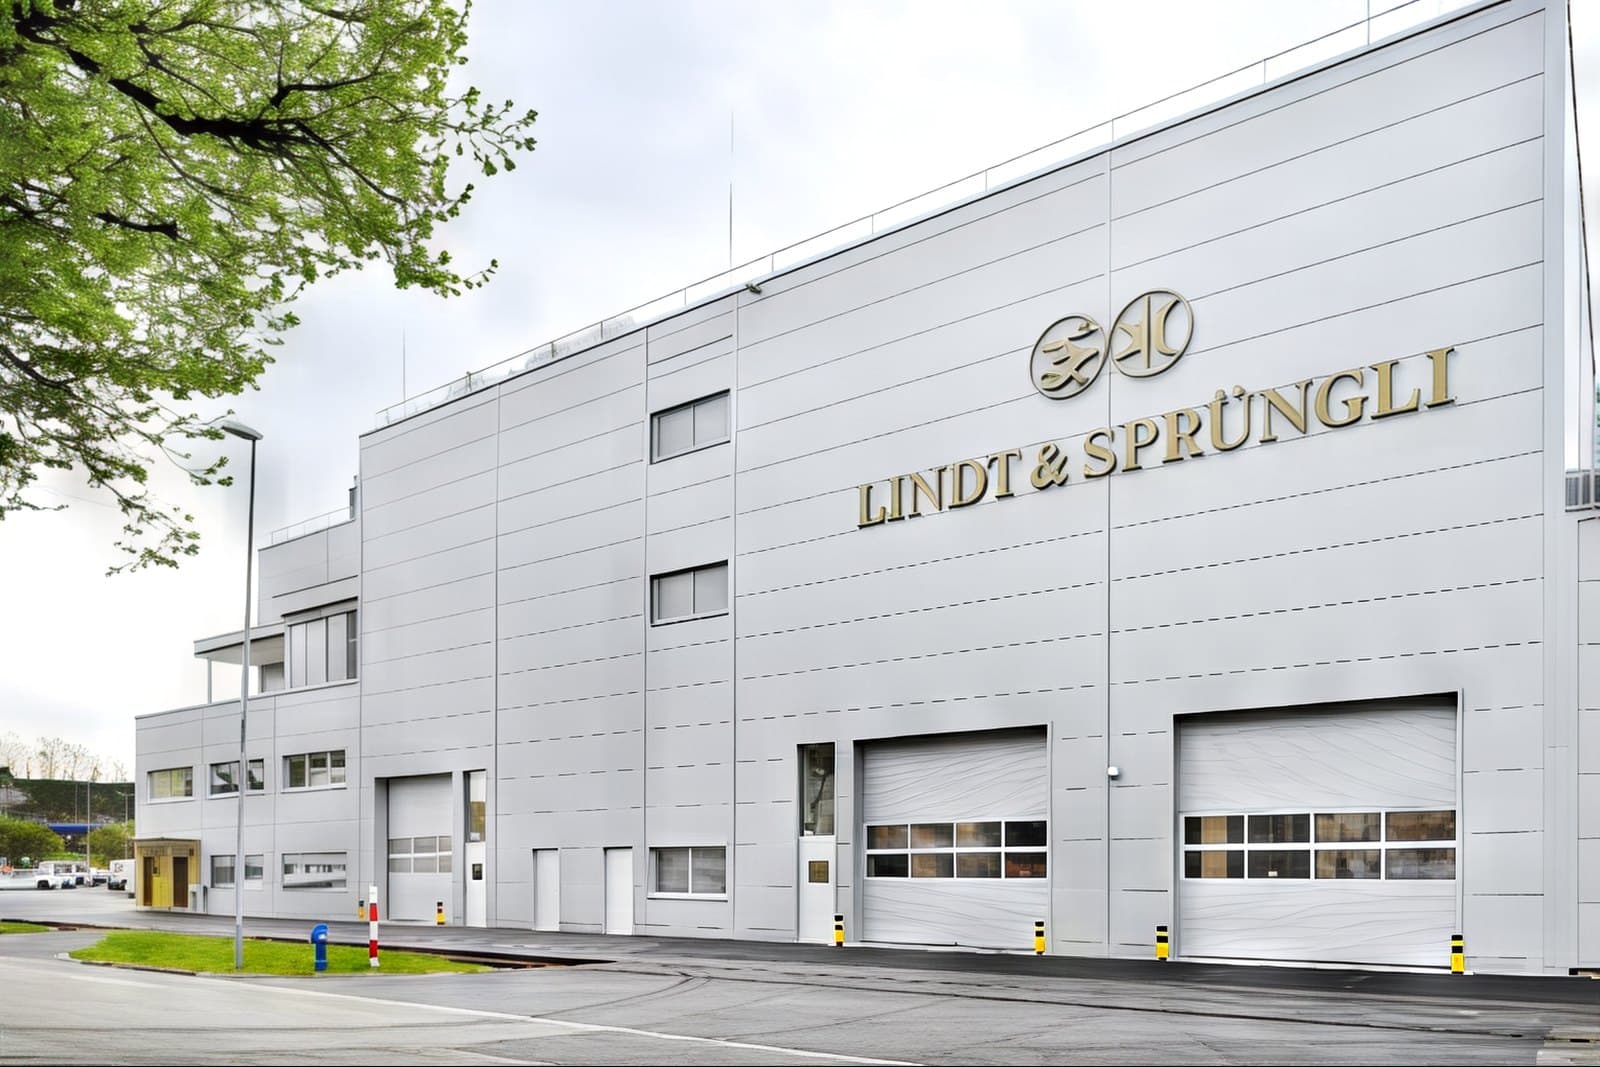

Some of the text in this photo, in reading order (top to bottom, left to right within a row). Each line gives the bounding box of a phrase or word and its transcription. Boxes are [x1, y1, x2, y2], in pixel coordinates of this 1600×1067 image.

[858, 347, 1455, 528] LINDT & SPRÜNGLI
